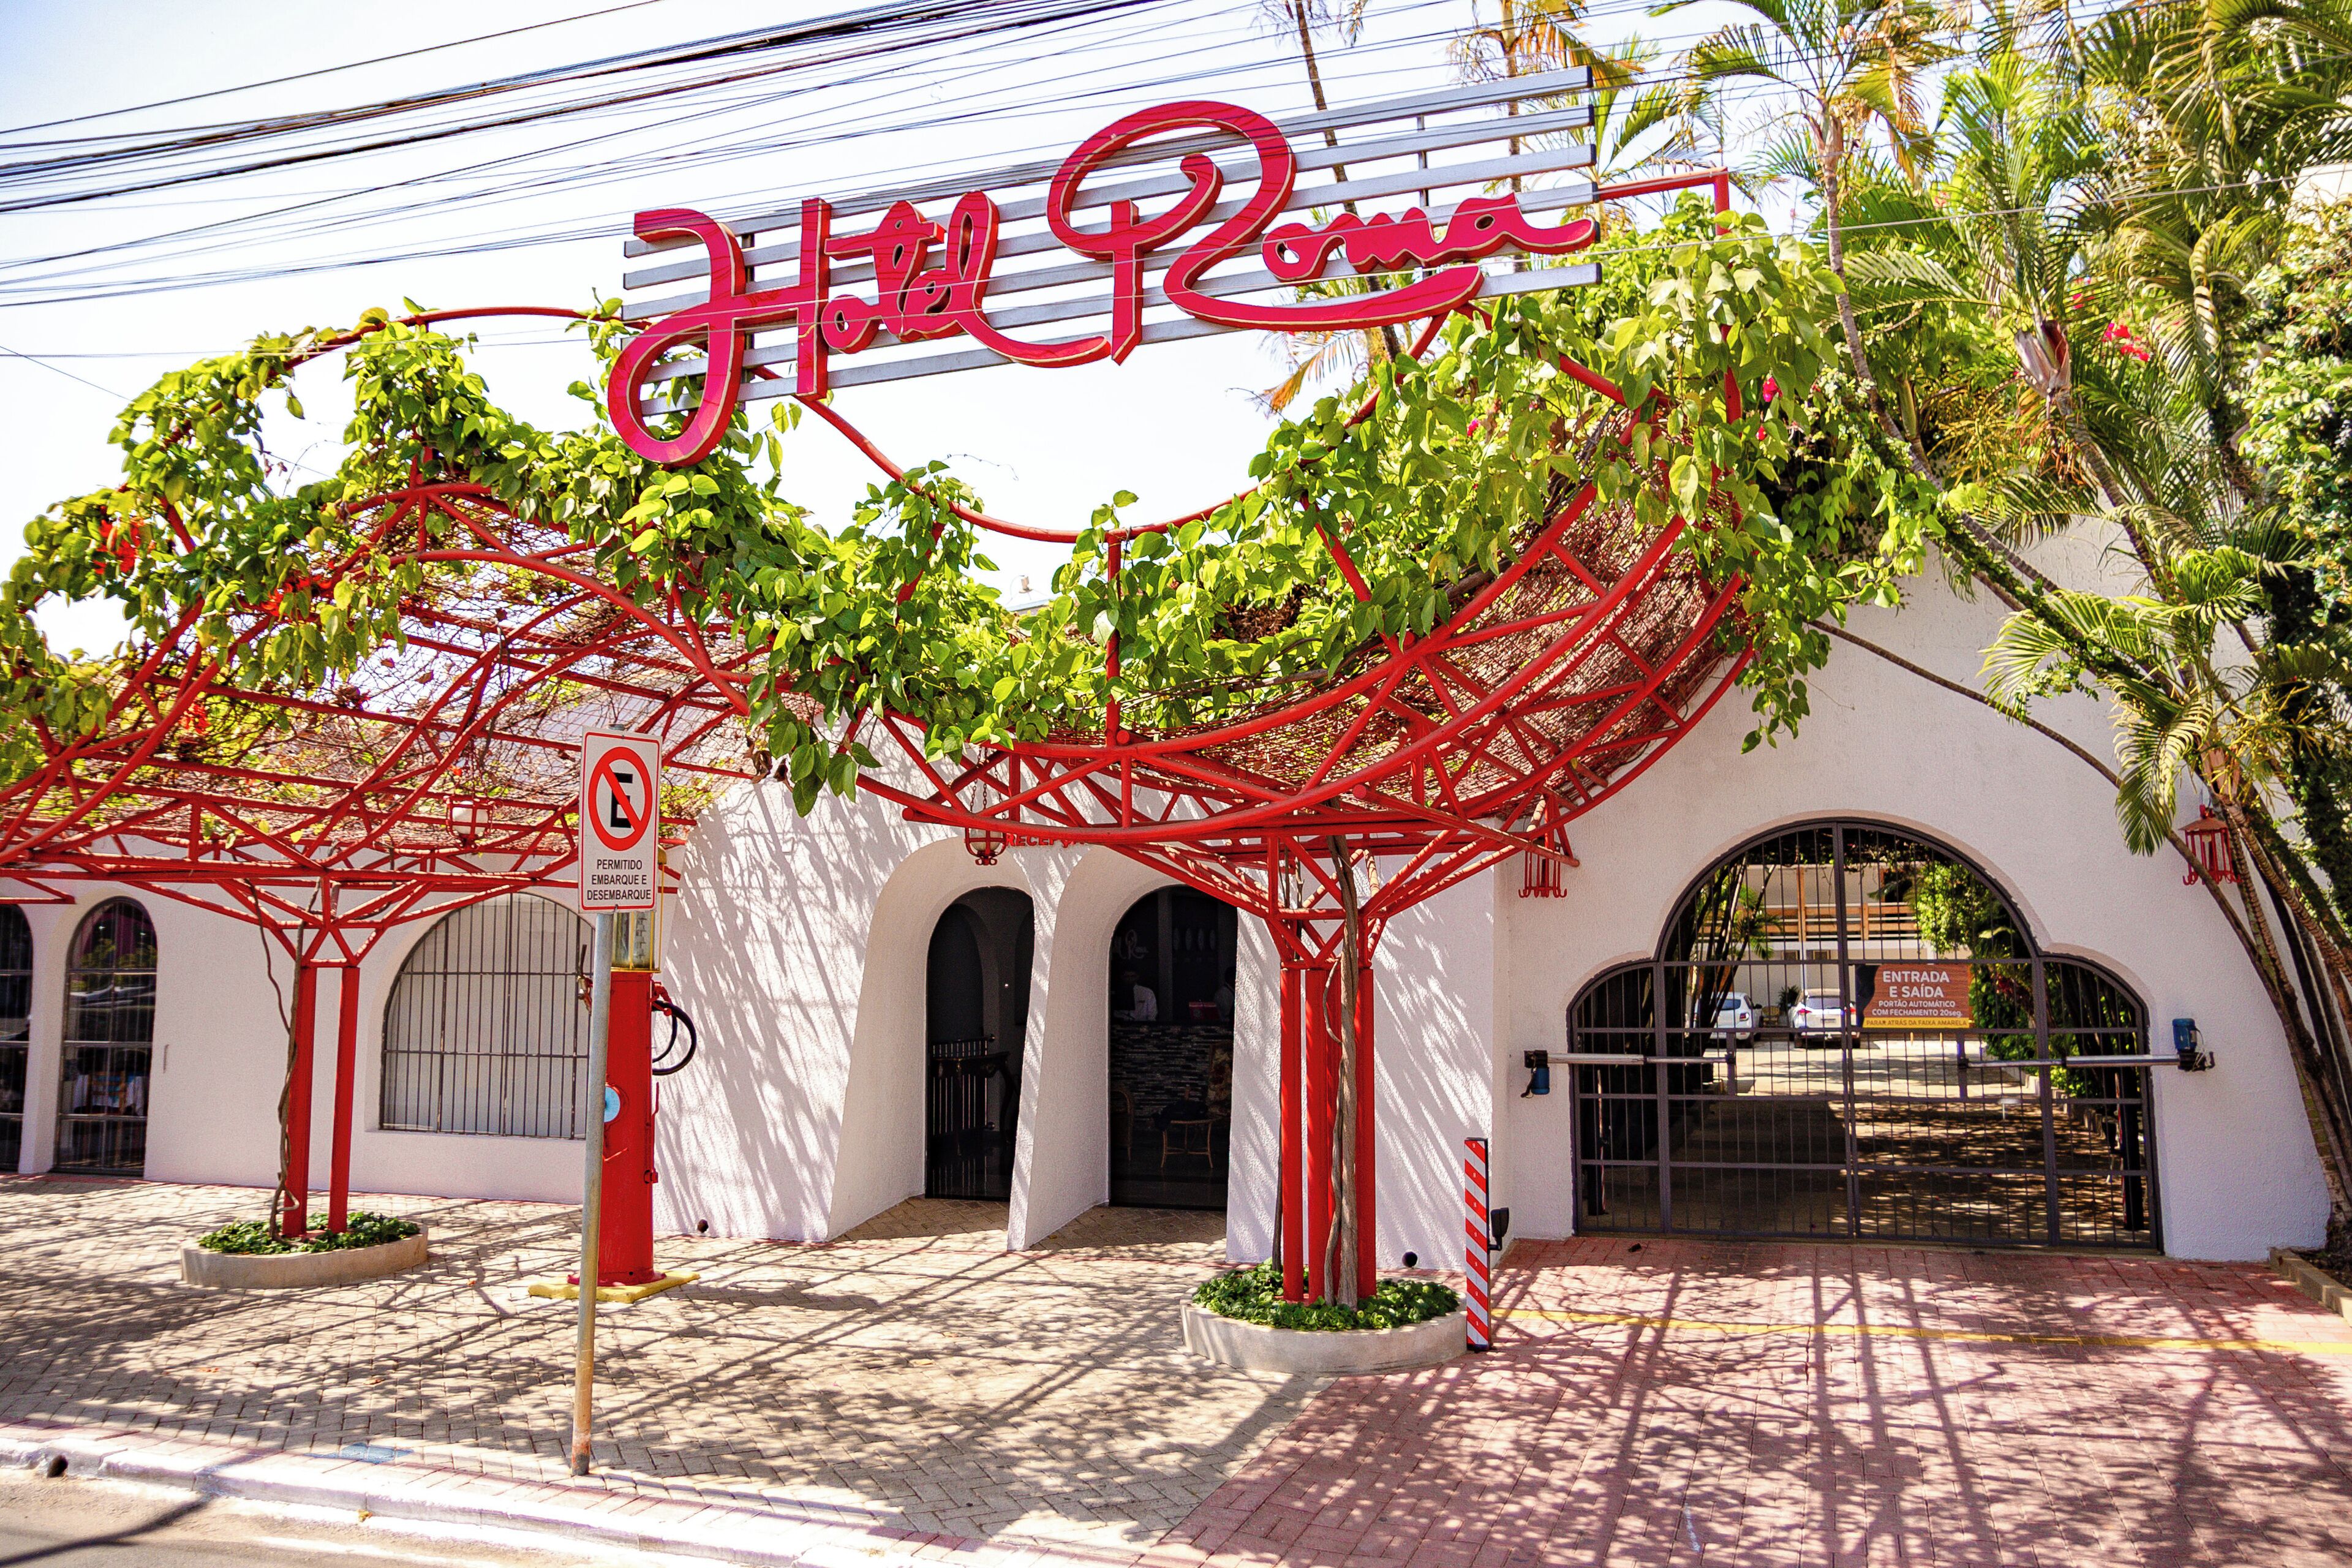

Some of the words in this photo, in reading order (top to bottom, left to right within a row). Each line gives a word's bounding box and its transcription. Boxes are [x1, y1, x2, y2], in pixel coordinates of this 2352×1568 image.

[608, 189, 1111, 467] Hotel
[1047, 100, 1596, 366] Roma
[597, 859, 643, 870] PERMITIDO
[592, 874, 639, 885] EMBARQUE
[642, 875, 647, 884] E
[587, 889, 651, 901] DESEMBARQUE
[1883, 971, 1950, 983] ENTRADA
[1889, 986, 1898, 998] E
[1901, 983, 1944, 998] SAÍDA
[1879, 999, 1908, 1008] PORTÃO
[1909, 999, 1956, 1008] AUTOMÁTICO
